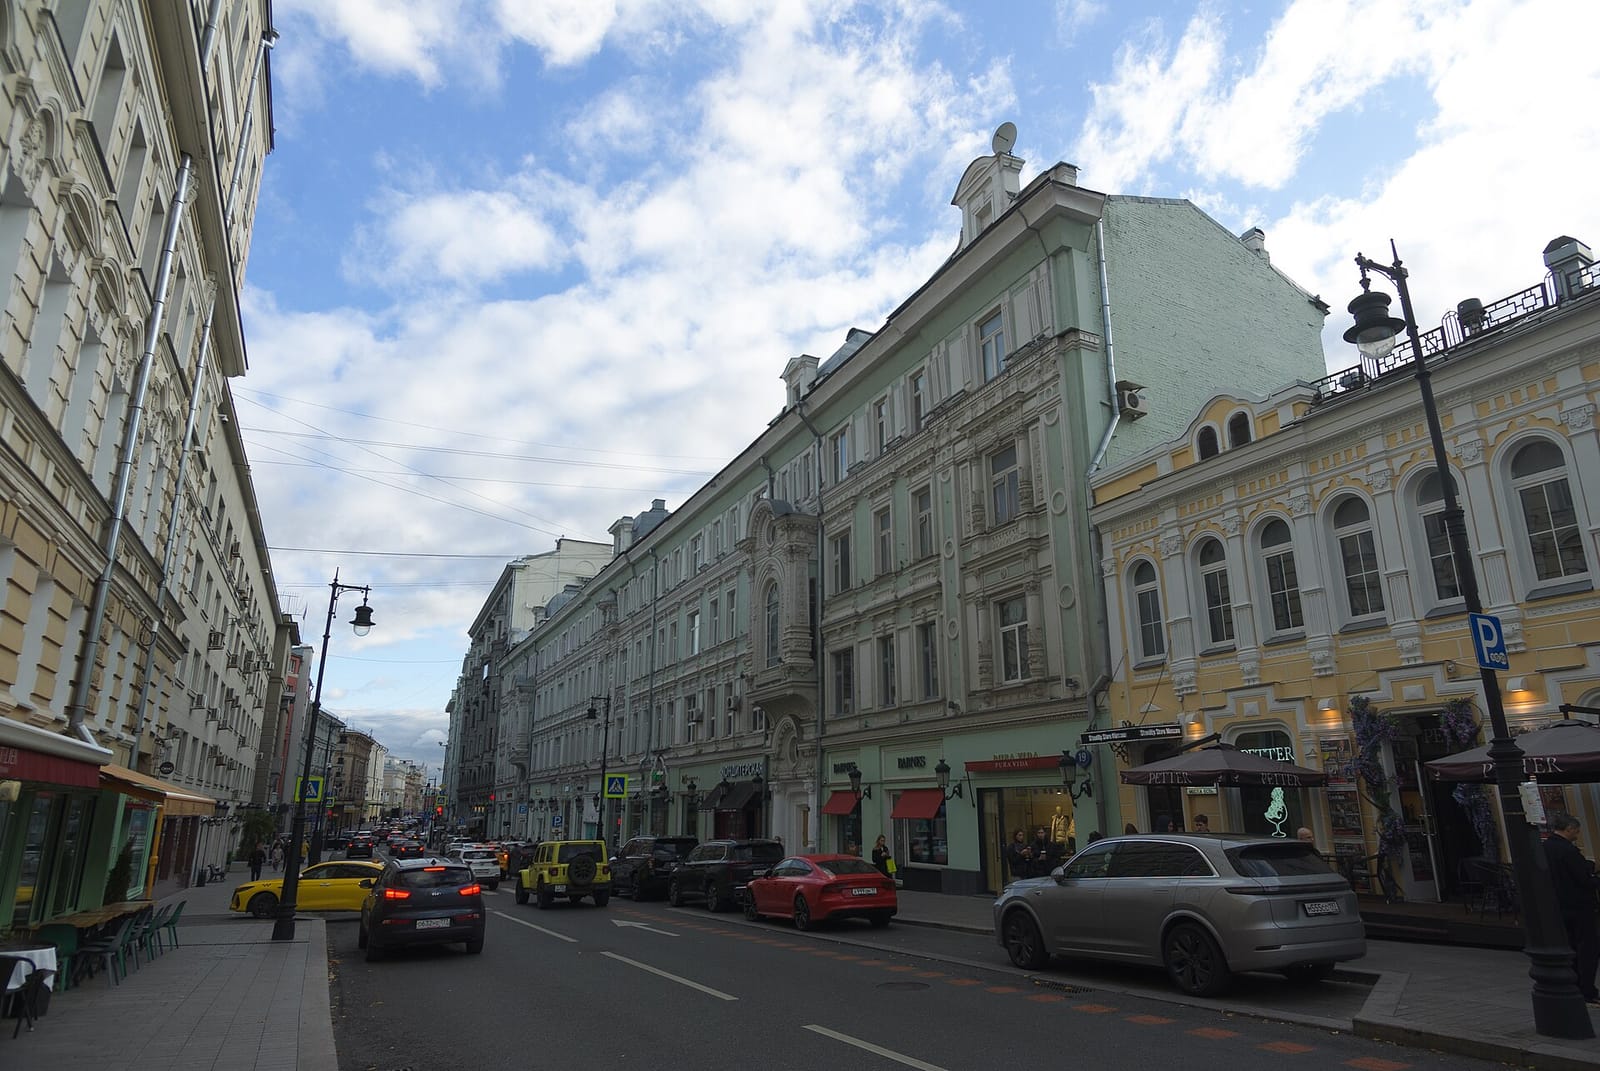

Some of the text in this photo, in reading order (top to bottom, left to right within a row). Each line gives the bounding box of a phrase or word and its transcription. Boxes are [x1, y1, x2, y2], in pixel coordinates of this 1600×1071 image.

[1476, 617, 1498, 664] P
[1078, 752, 1087, 763] 19
[1240, 746, 1295, 761] TTER
[1481, 757, 1568, 778] PTER
[1148, 771, 1192, 785] PETTER
[1261, 772, 1302, 786] PETTER
